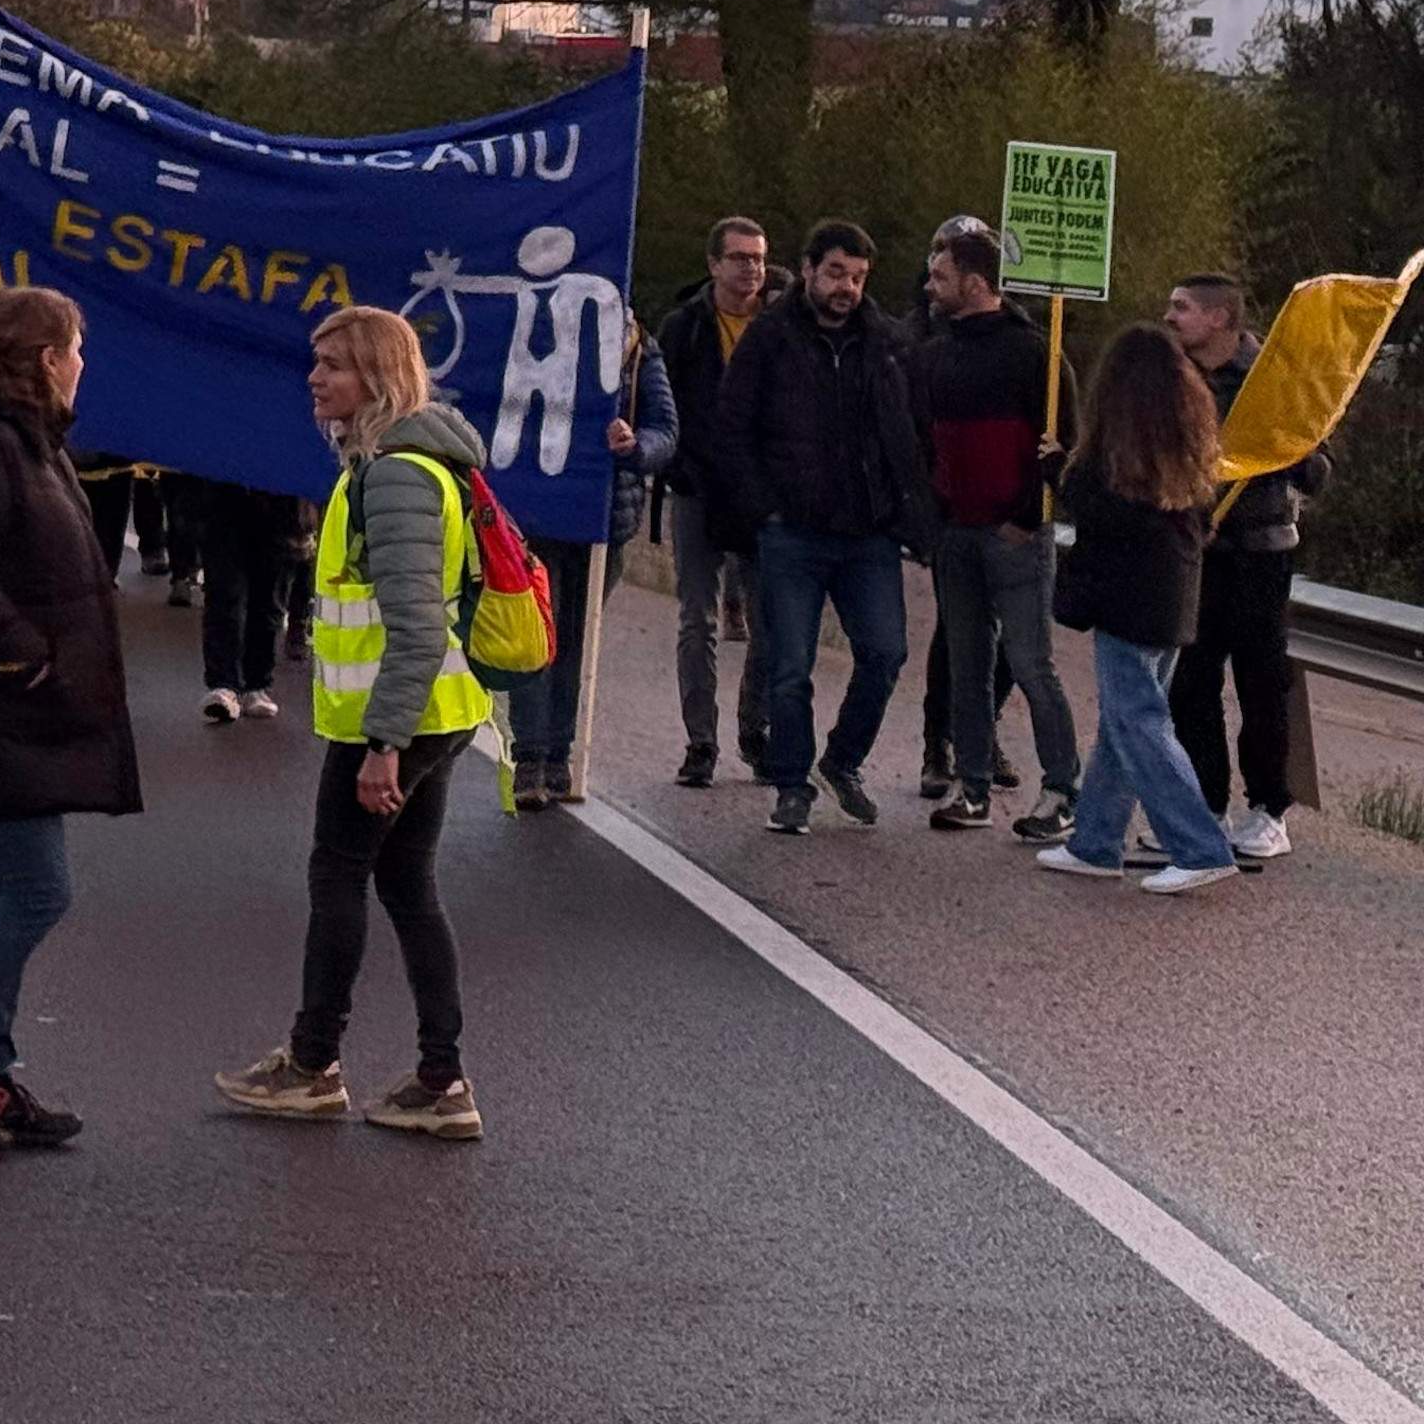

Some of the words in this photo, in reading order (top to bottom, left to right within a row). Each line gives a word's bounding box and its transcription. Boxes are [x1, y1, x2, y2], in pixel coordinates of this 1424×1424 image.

[1046, 156, 1106, 180] VAGA
[1012, 175, 1107, 201] EDUCATIVA
[54, 198, 353, 314] ESTAFA
